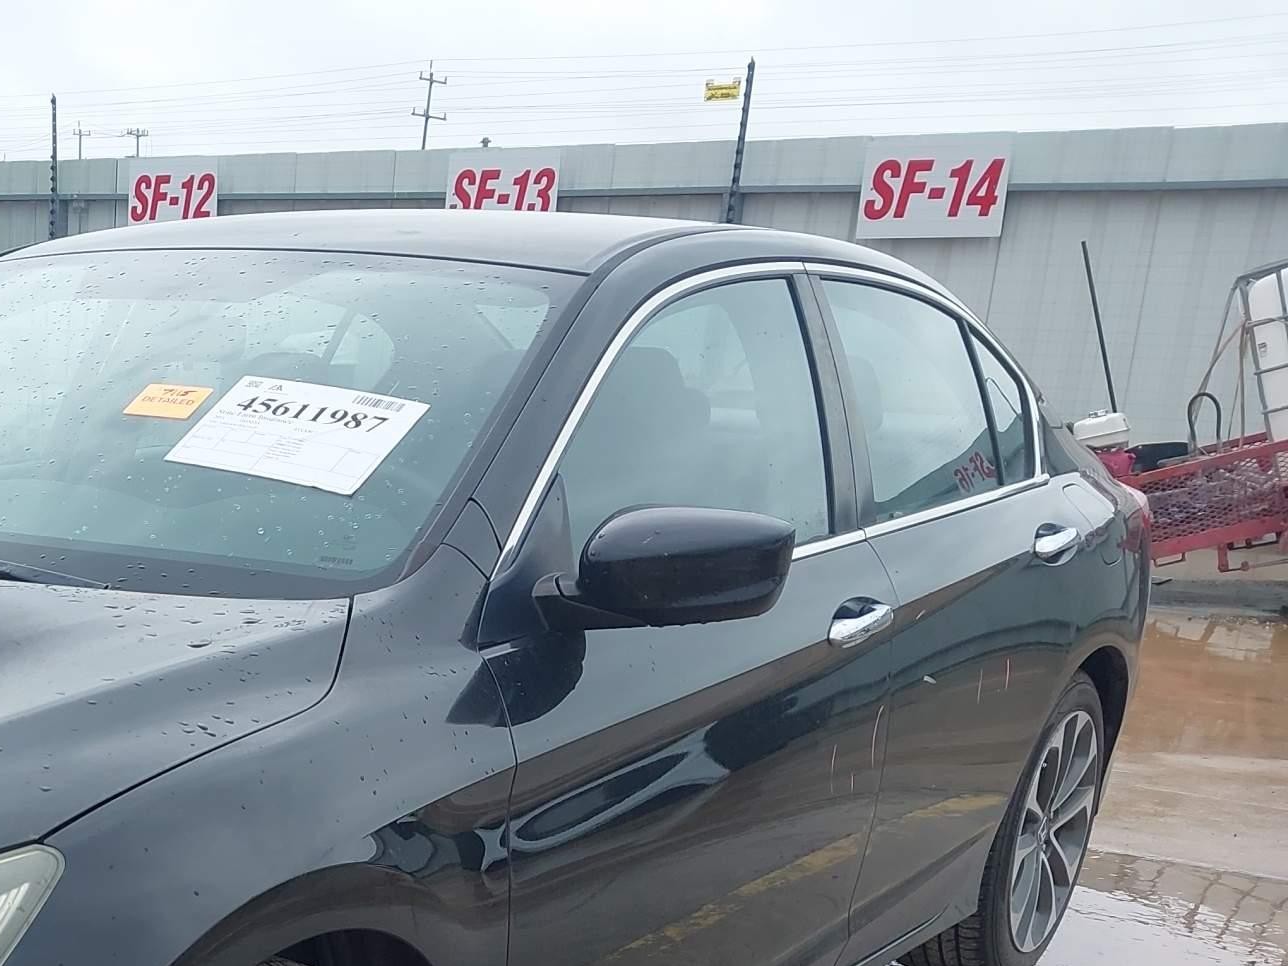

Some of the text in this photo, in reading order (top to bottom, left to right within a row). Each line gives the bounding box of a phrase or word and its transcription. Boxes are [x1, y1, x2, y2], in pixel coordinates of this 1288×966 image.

[130, 173, 216, 222] SF-12
[449, 167, 556, 212] SF-13
[863, 158, 1006, 221] SF-14
[236, 395, 390, 433] 45611987
